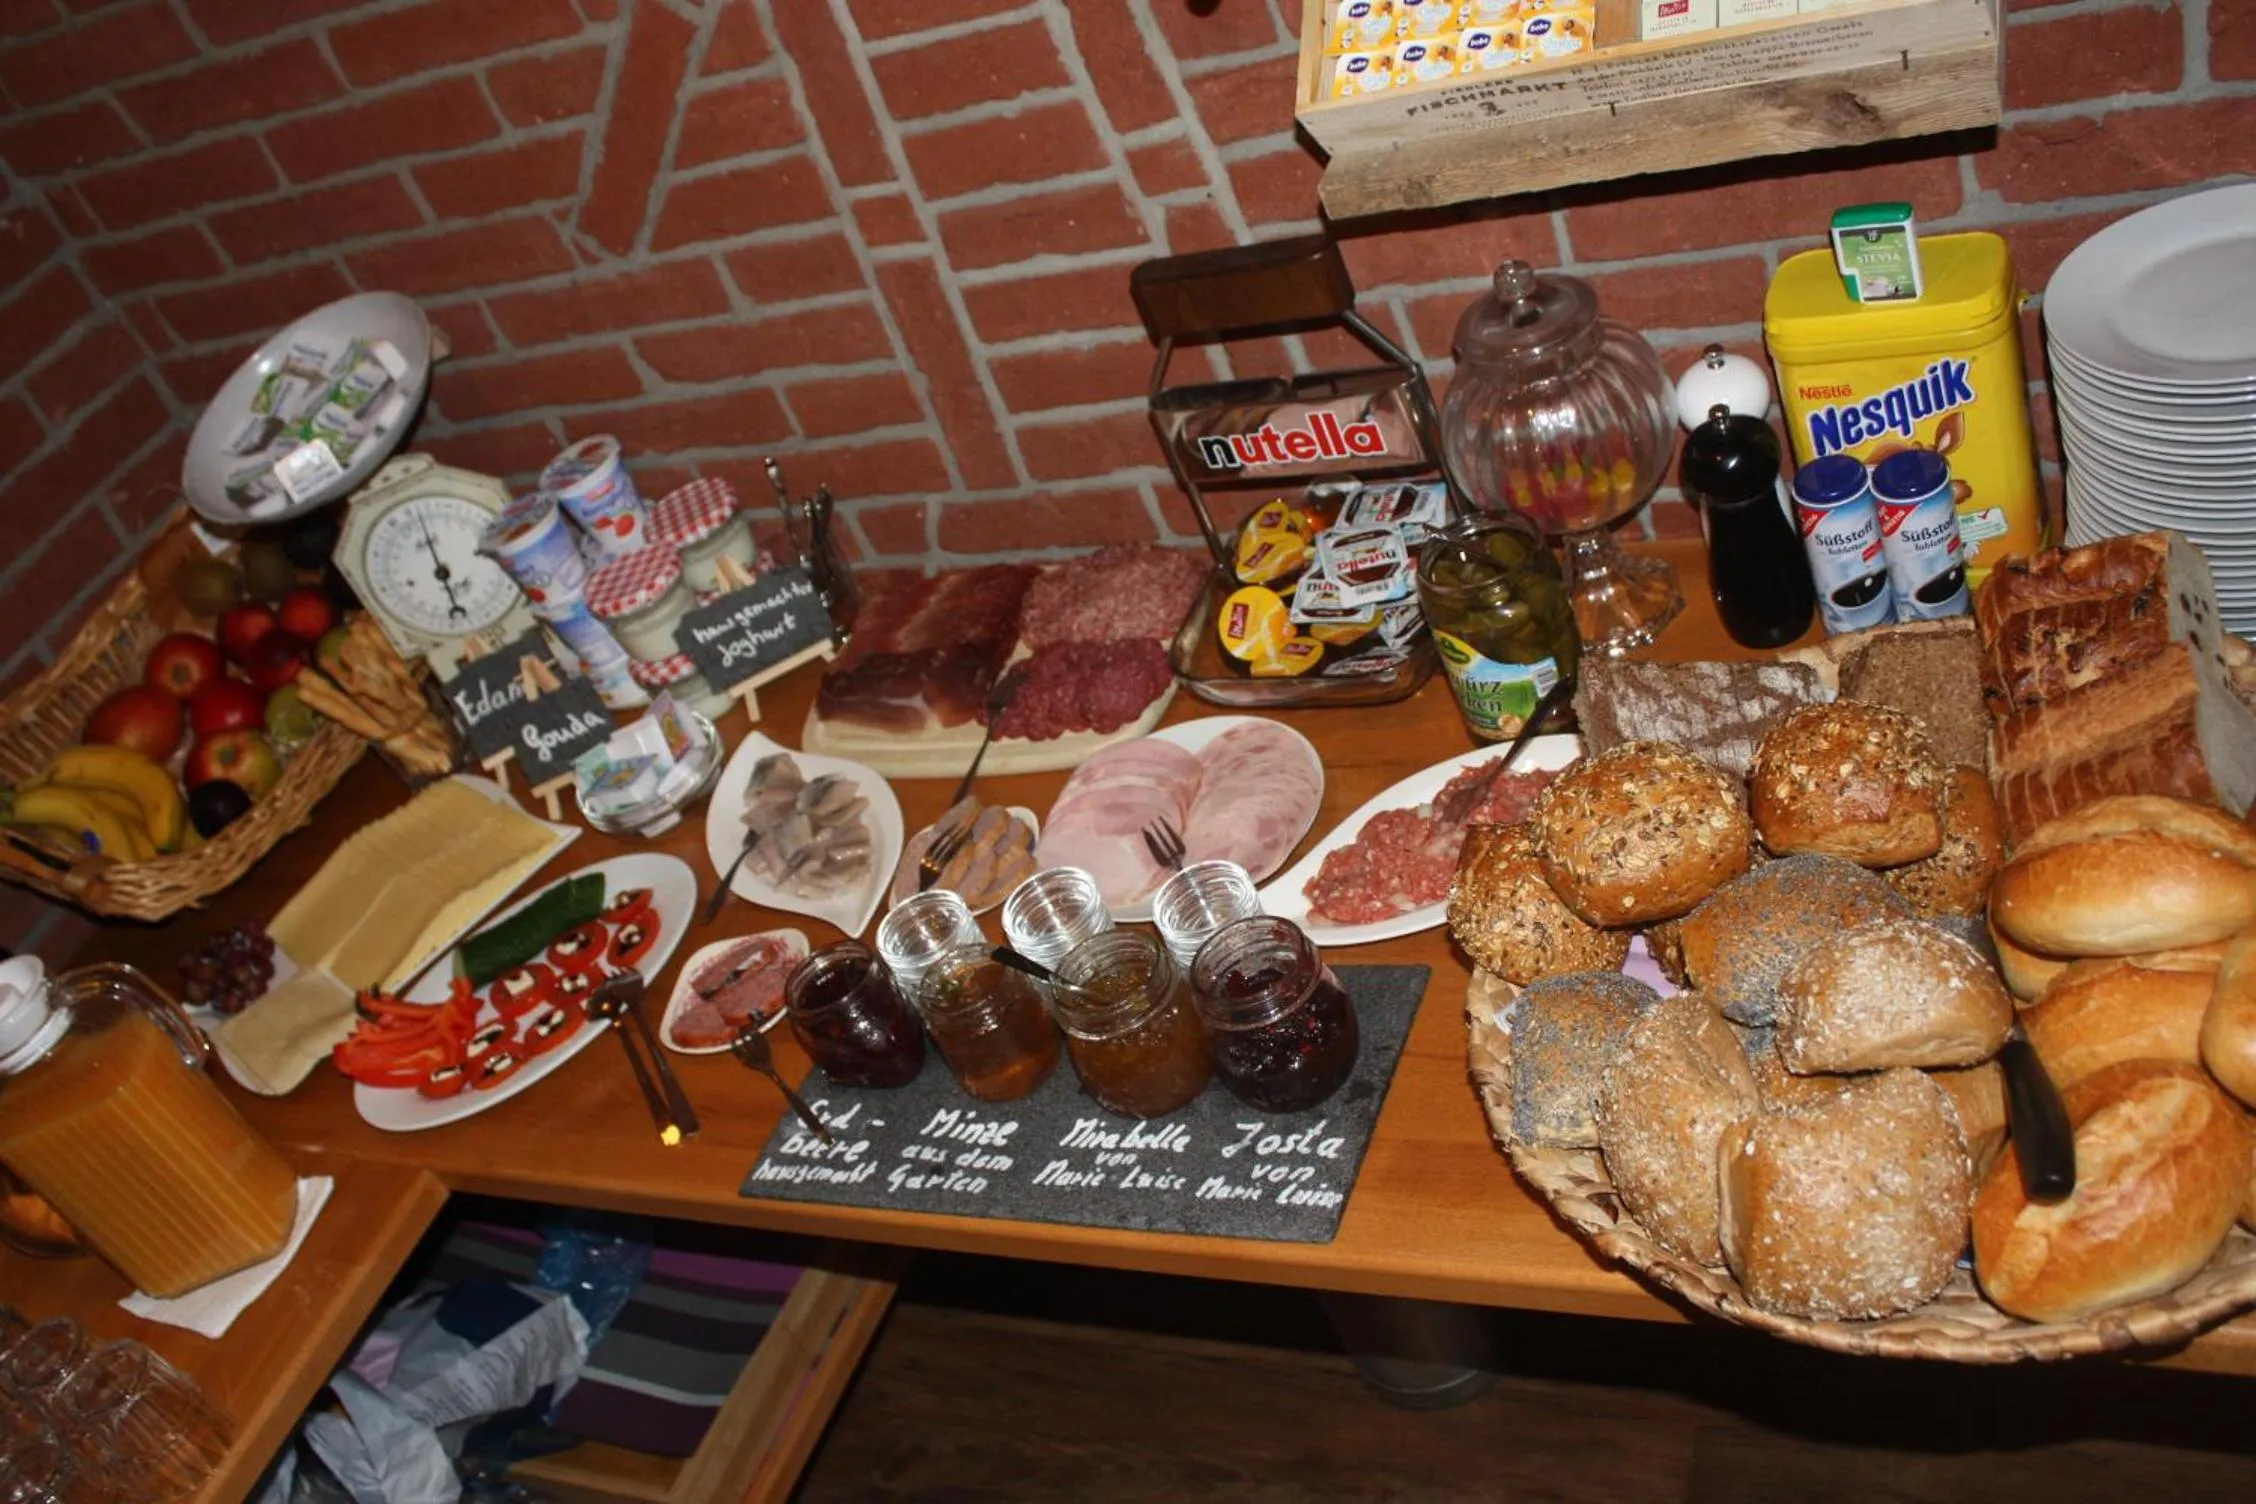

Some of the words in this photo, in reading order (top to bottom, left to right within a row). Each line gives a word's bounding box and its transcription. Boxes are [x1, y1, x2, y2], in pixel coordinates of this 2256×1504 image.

[1406, 82, 1567, 116] FISCHMARKT
[1808, 358, 1974, 456] Nesquik
[1200, 413, 1386, 467] nutella
[1815, 518, 1873, 546] Süßstoff
[521, 711, 606, 762] Gouda
[920, 1108, 1019, 1146] Minze
[1059, 1118, 1190, 1152] Mirabelle
[1222, 1119, 1345, 1158] Josta
[902, 1144, 948, 1163] aus
[955, 1148, 1013, 1171] dem
[1095, 1152, 1137, 1166] von
[1252, 1163, 1315, 1182] von
[887, 1163, 988, 1193] Garten
[1033, 1160, 1101, 1187] Marie
[1119, 1166, 1187, 1189] Luise
[1195, 1175, 1262, 1200] Marie
